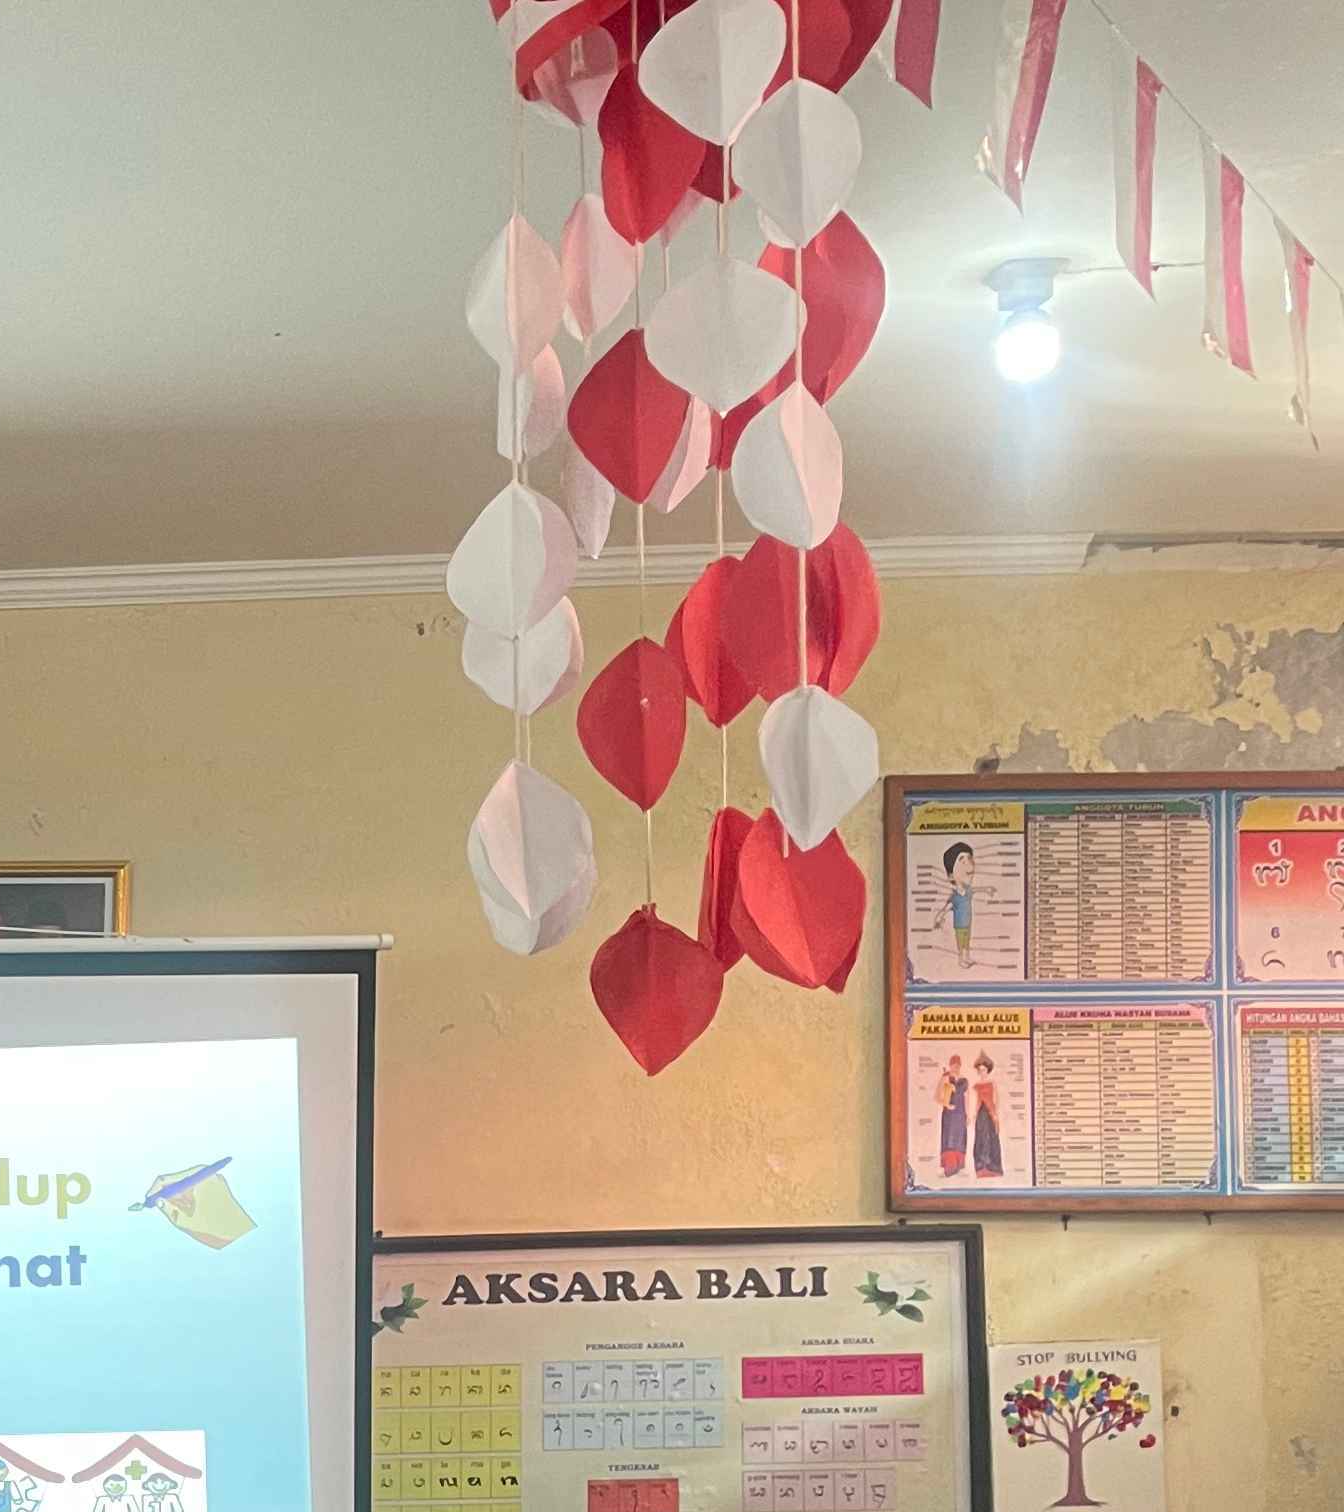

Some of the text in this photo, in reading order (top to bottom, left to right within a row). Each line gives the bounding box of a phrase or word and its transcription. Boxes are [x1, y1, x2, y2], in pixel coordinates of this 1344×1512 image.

[923, 1014, 964, 1023] BAHASA
[967, 1014, 990, 1023] BALI
[921, 1025, 1021, 1035] PAKAIAN ADAT BALI
[442, 1265, 828, 1305] AKSARA BALI
[1017, 1349, 1137, 1366] STOP BULLYING
